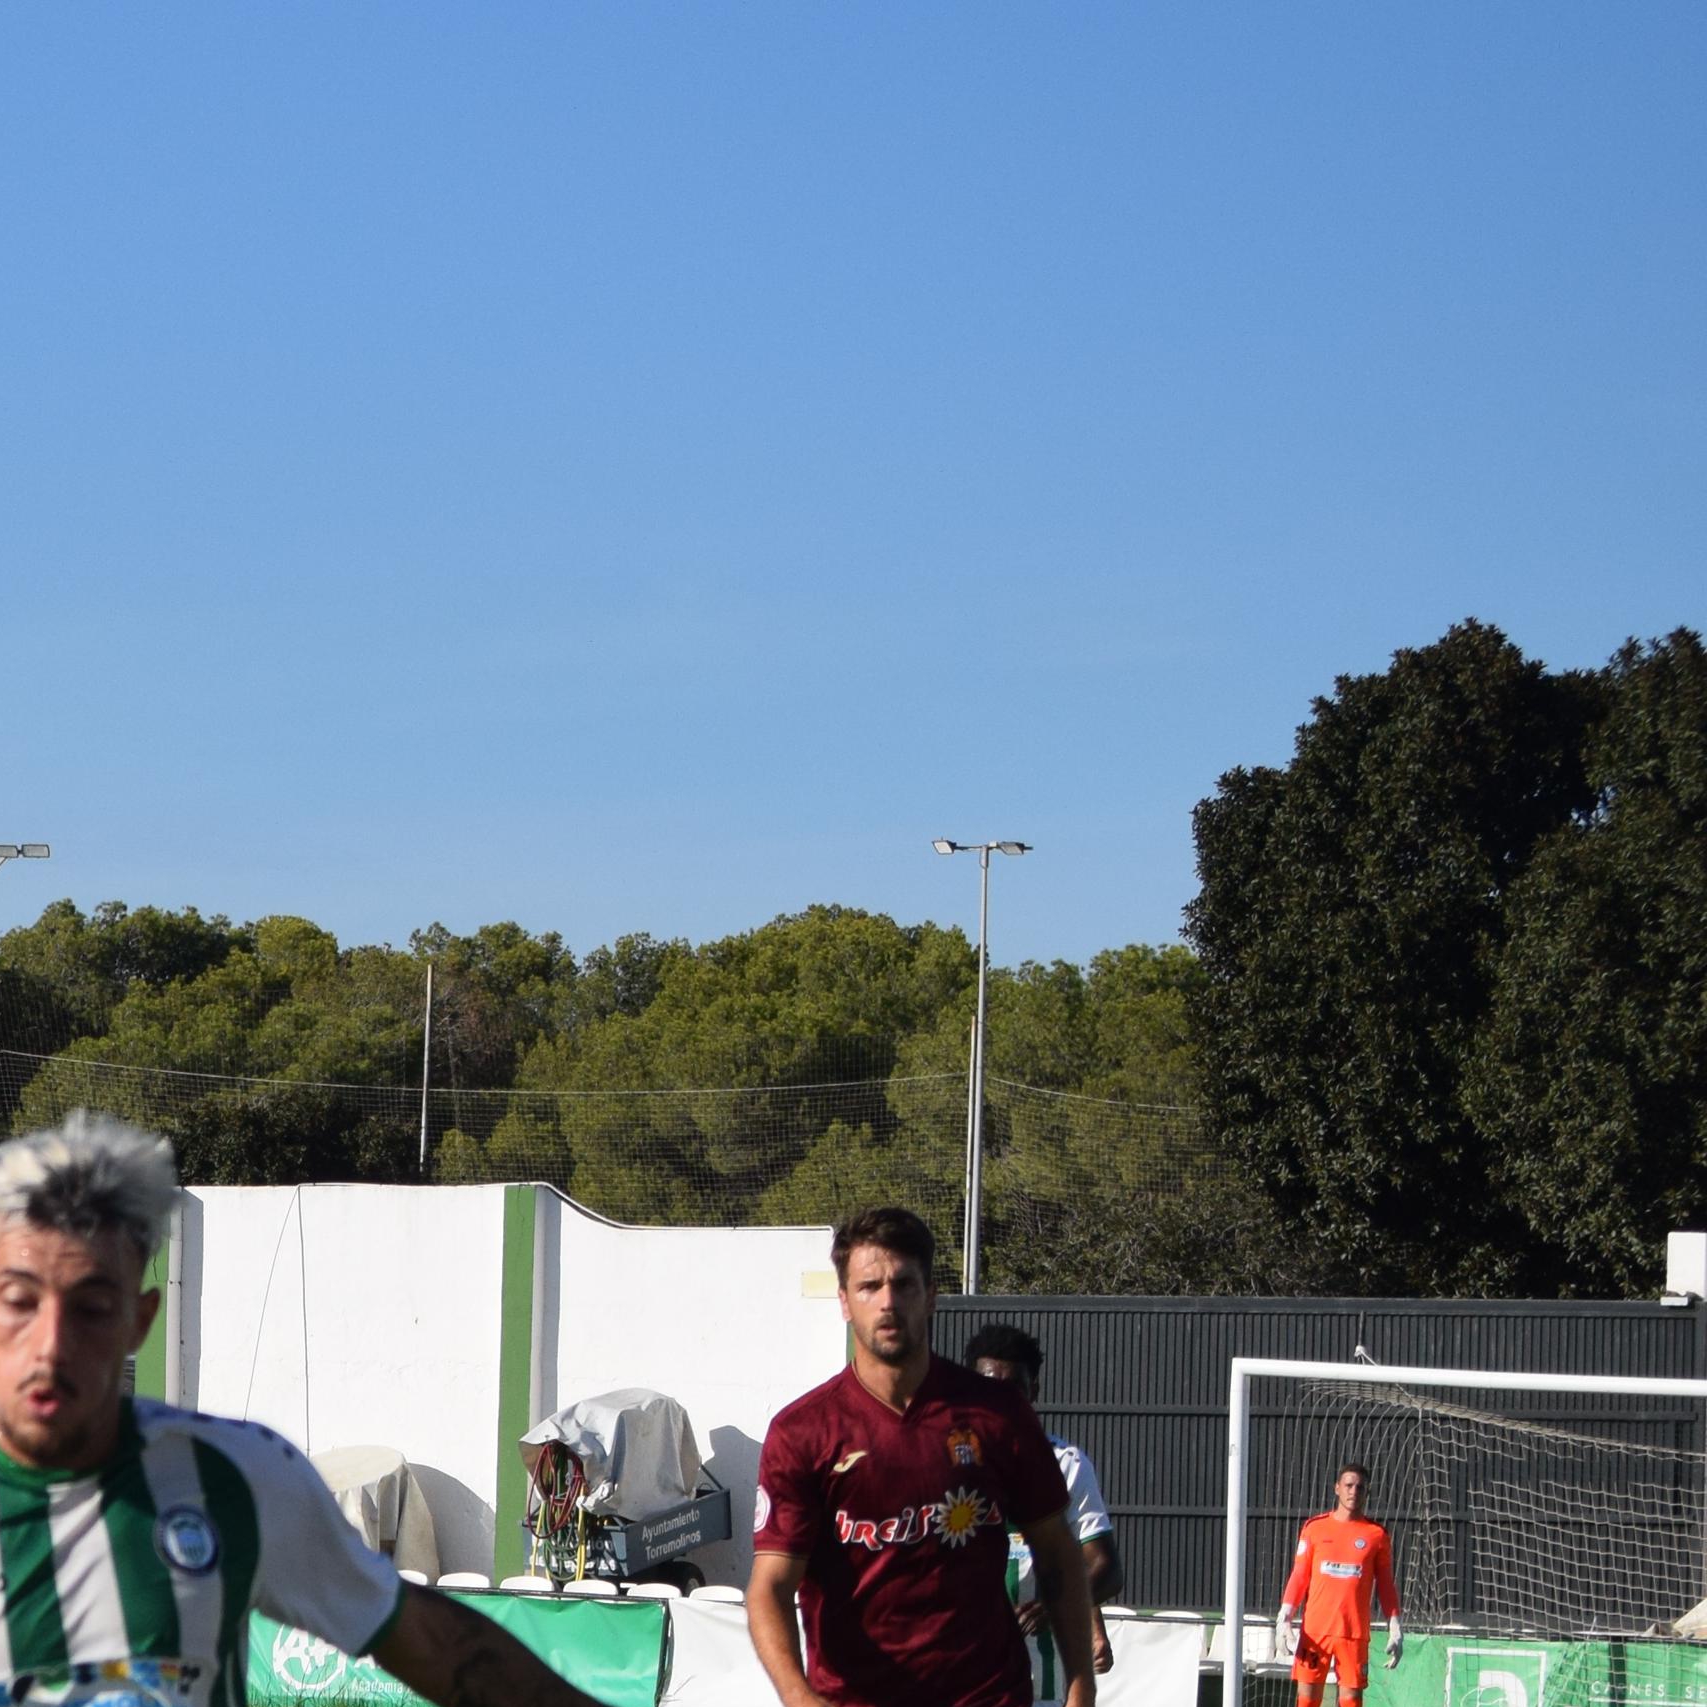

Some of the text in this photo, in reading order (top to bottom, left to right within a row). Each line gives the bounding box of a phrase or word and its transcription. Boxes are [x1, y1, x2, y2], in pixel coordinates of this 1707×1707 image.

[642, 1509, 701, 1543] Ayuntamiento
[645, 1531, 702, 1561] Torremolinos
[350, 1678, 405, 1694] Academia
